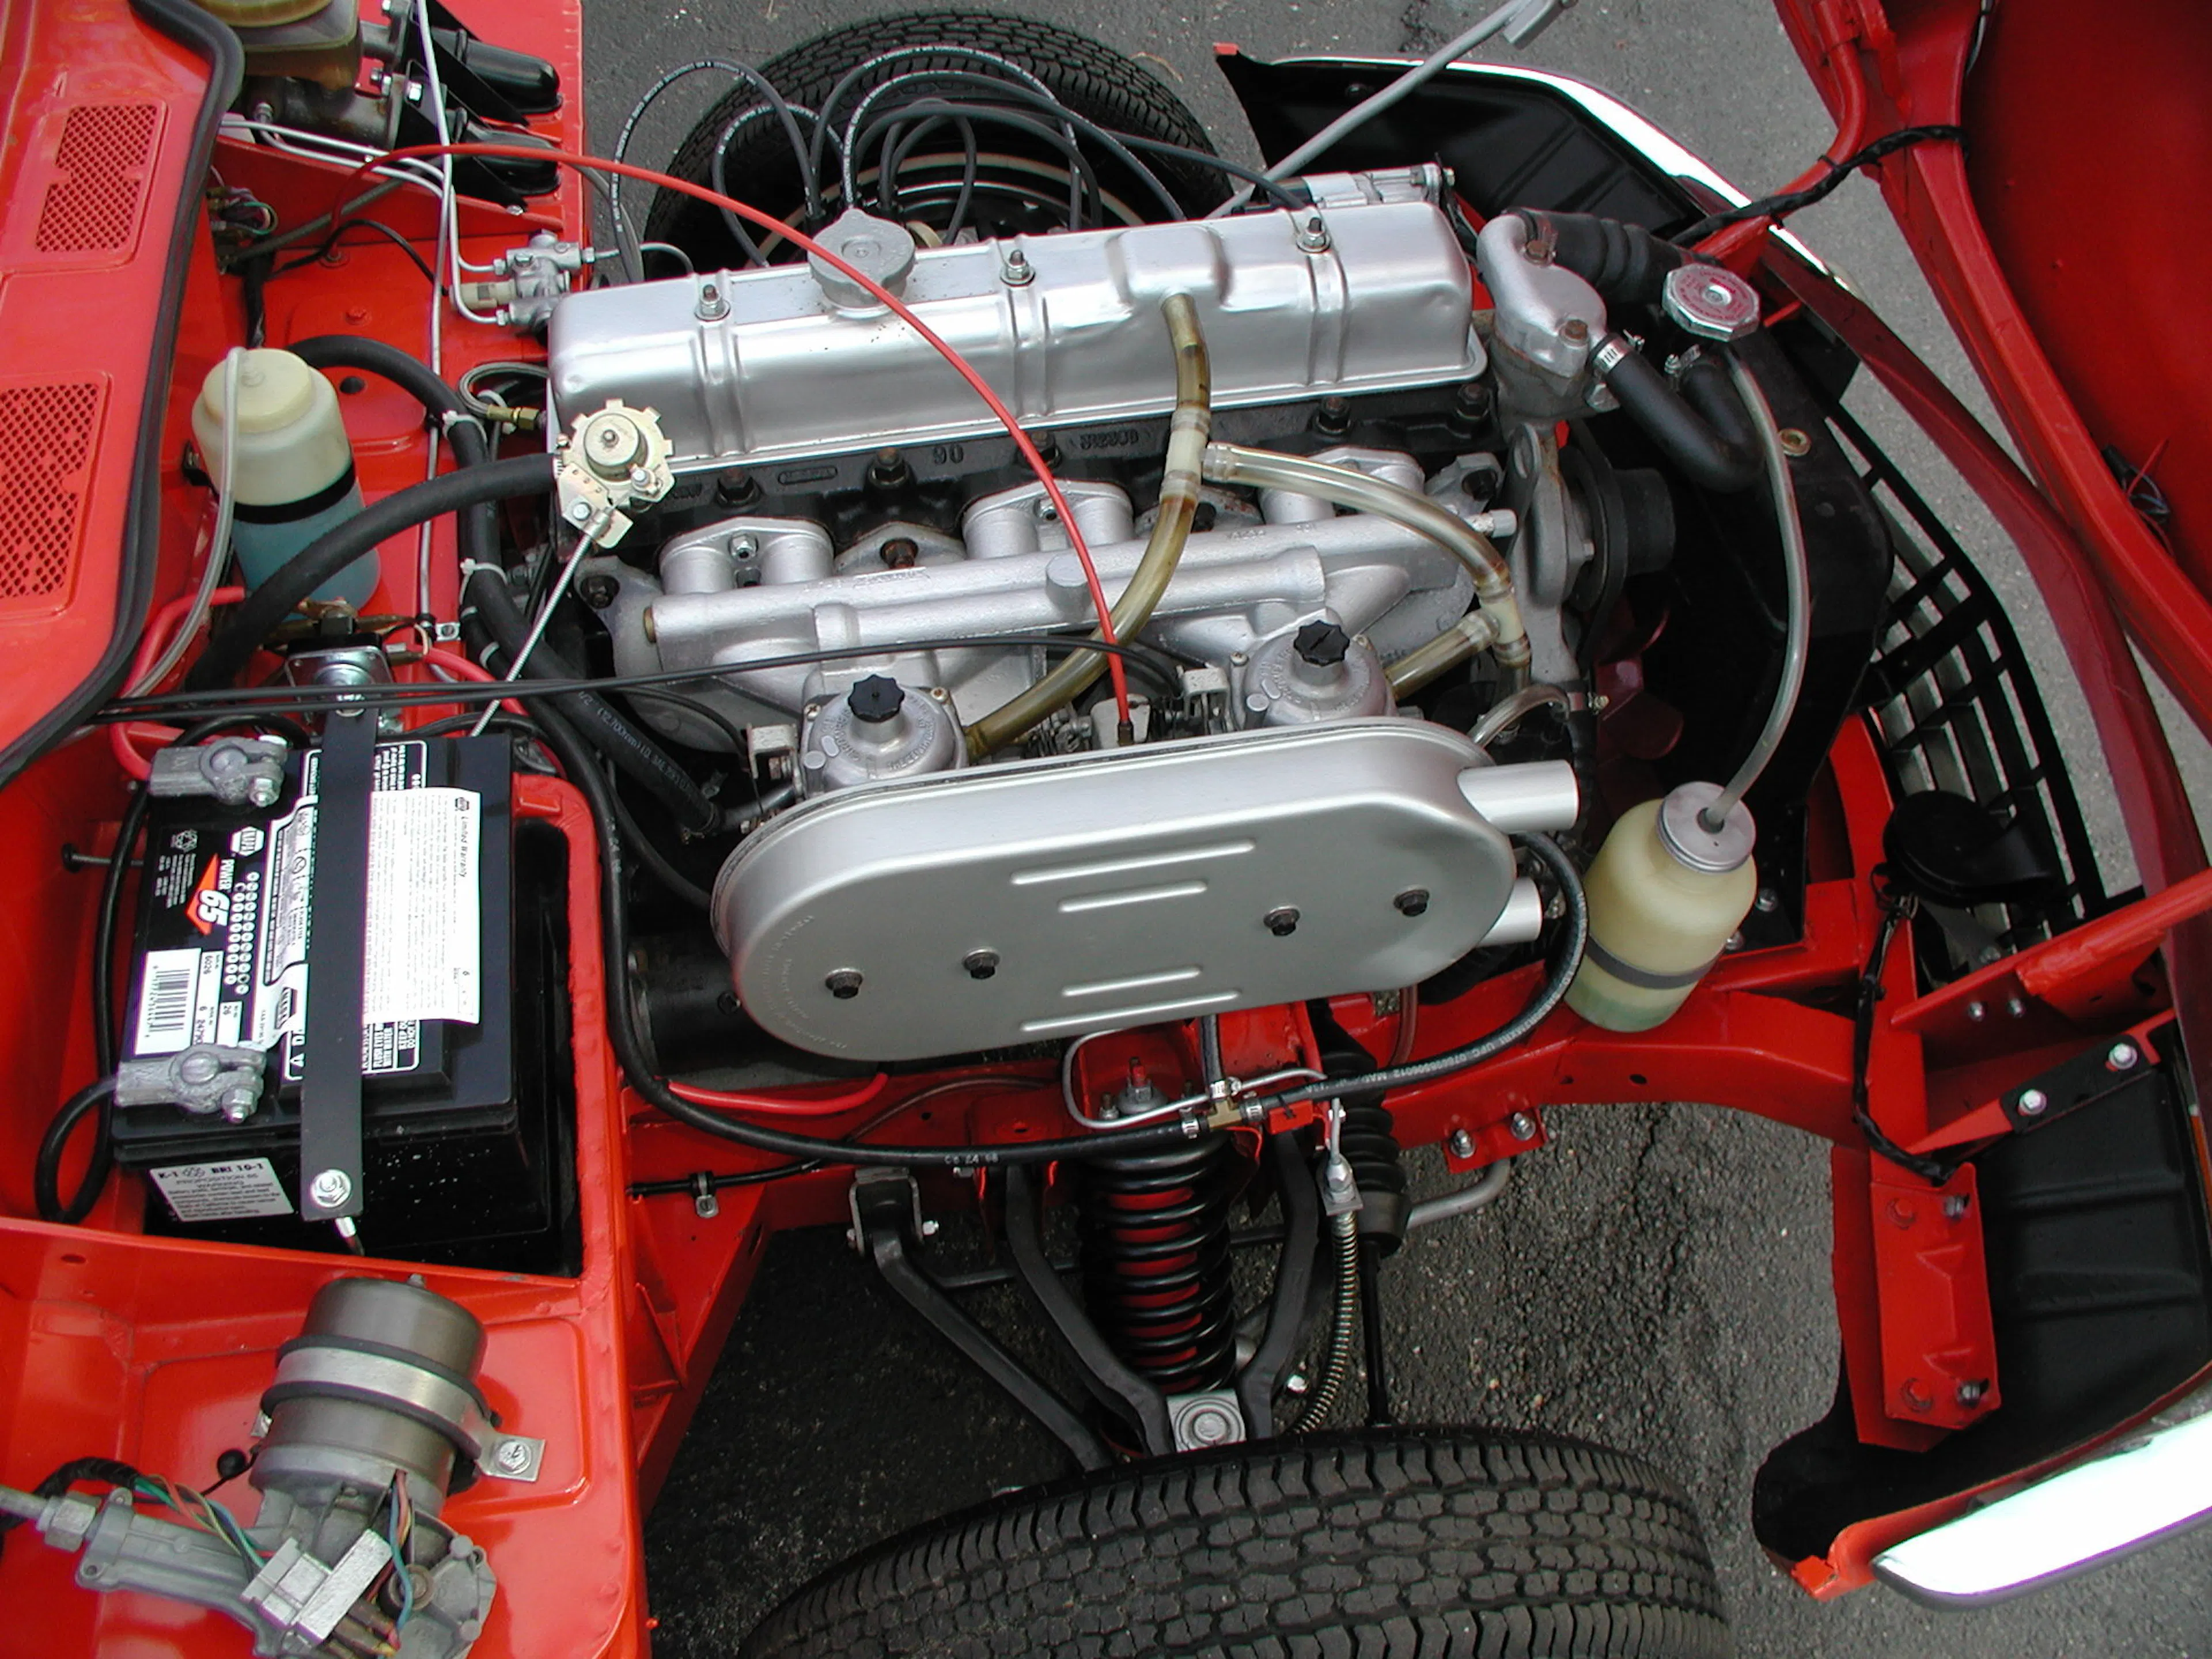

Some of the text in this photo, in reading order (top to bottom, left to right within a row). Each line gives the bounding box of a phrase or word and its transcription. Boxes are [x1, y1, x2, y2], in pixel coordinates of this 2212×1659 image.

[932, 442, 964, 464] 90
[219, 859, 234, 890] POWER
[198, 889, 230, 926] 65
